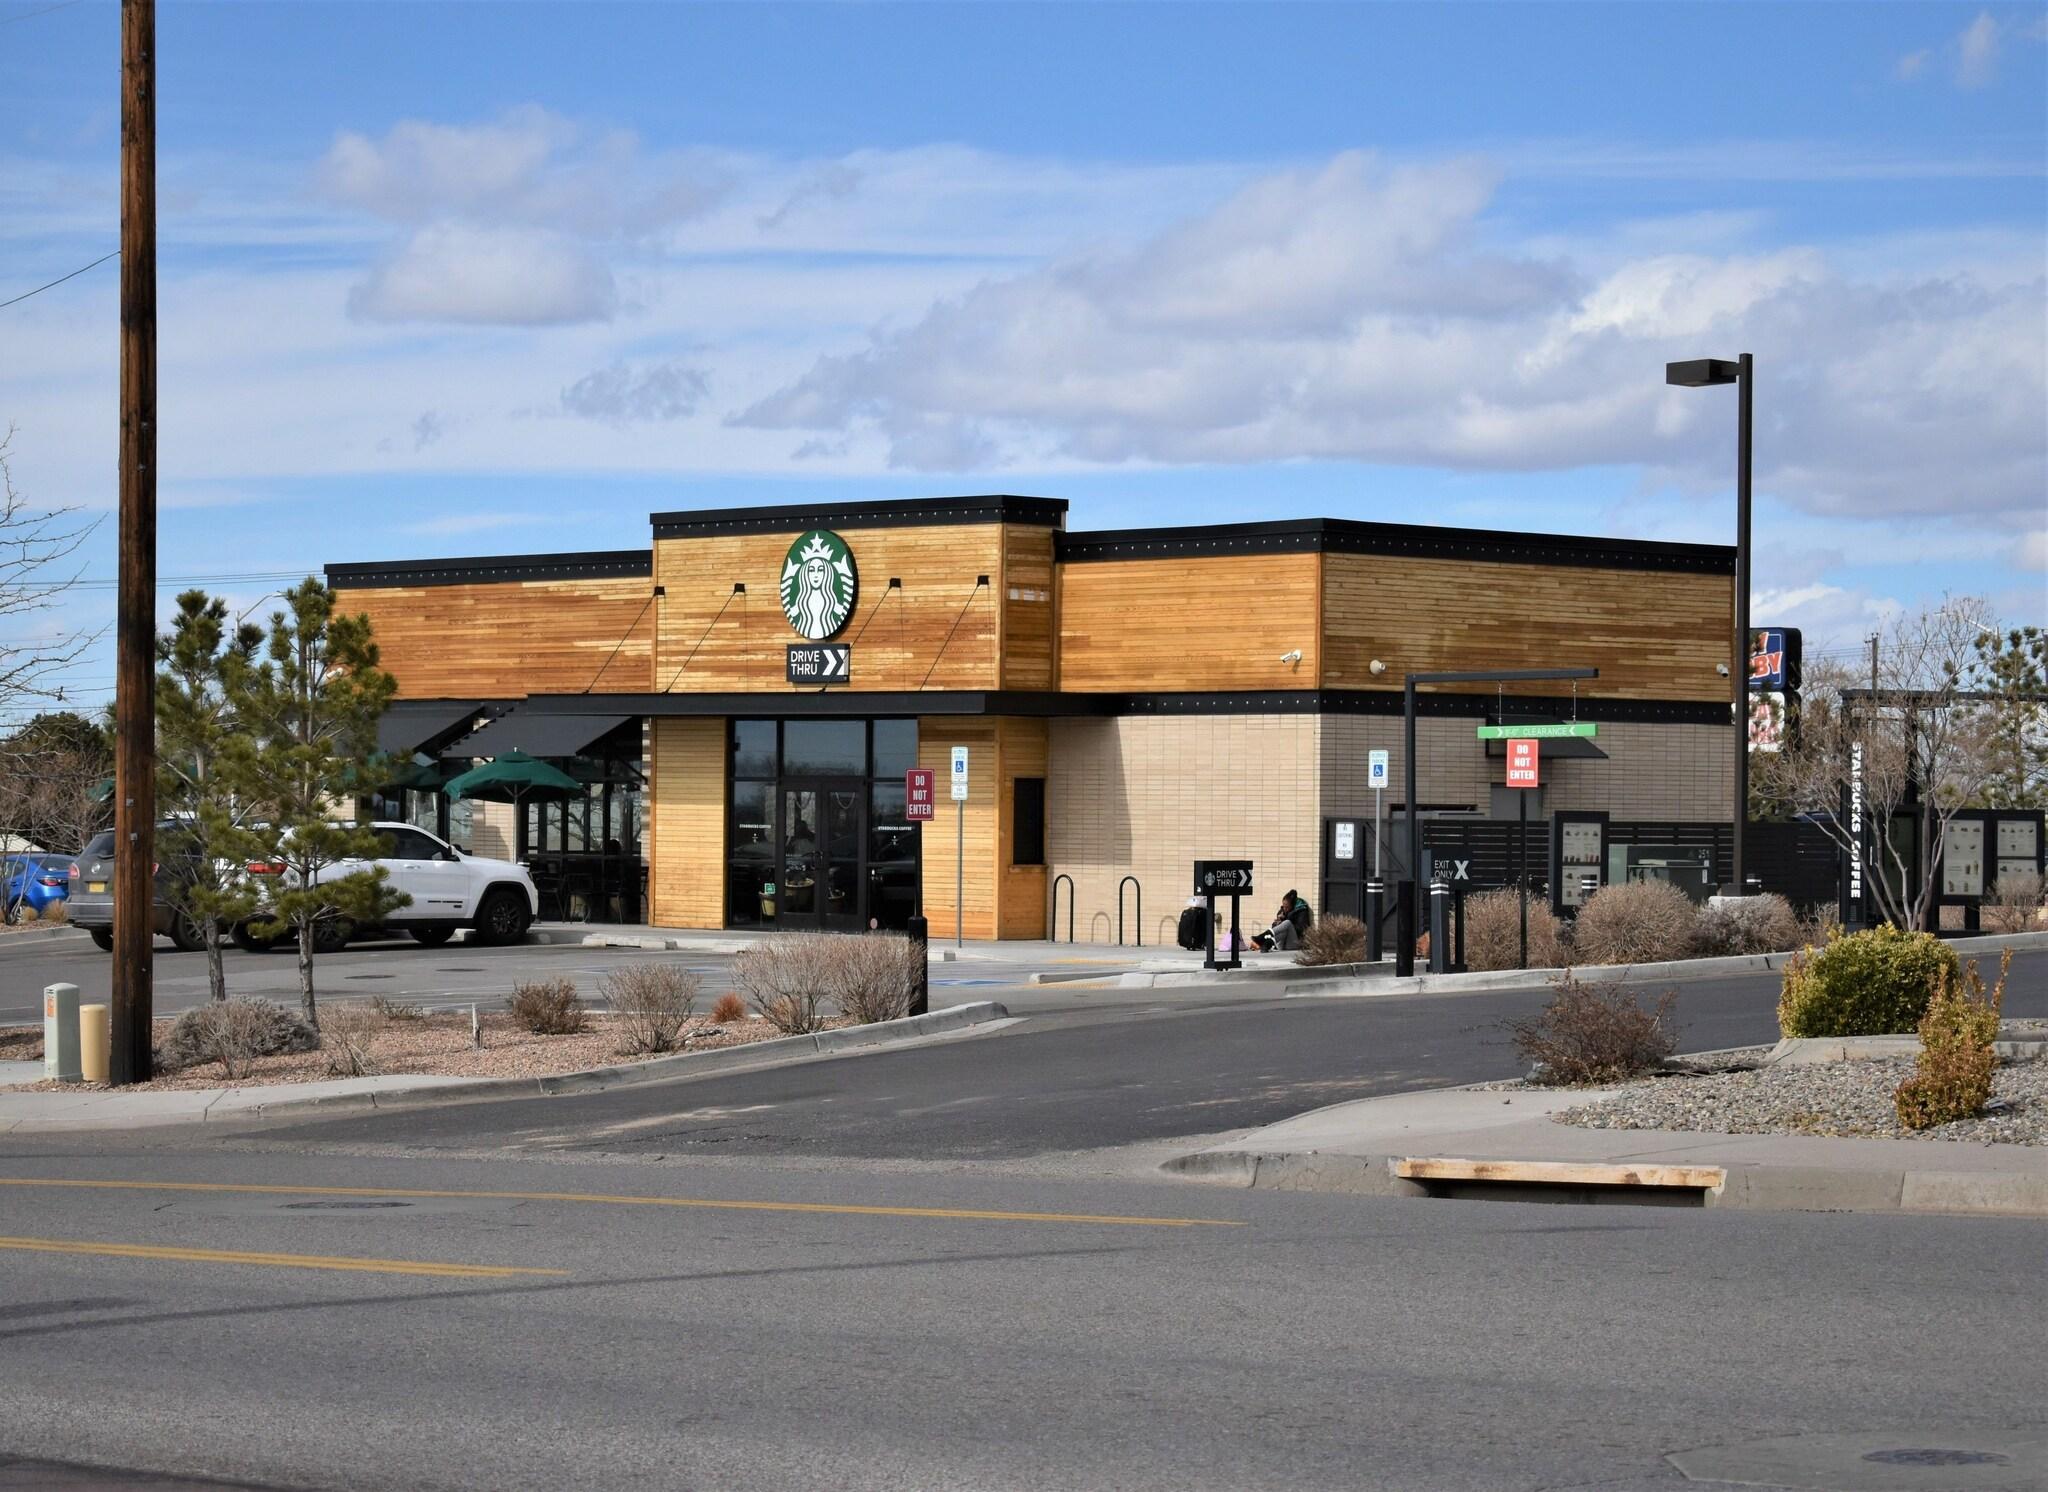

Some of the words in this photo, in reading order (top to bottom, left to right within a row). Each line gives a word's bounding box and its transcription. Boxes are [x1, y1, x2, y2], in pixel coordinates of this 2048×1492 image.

[790, 650, 820, 662] DRIVE
[791, 663, 818, 675] THRU
[1523, 726, 1567, 736] CLEARANCE
[1516, 744, 1529, 754] DO
[1514, 757, 1531, 767] NOT
[1510, 769, 1535, 779] ENTER
[915, 775, 925, 786] DO
[912, 790, 927, 800] NOT
[909, 804, 931, 815] ENTER
[1434, 860, 1450, 869] EXIT
[1850, 840, 1861, 898] COFFEE
[1216, 870, 1237, 879] DRIVE
[1434, 870, 1454, 879] ONLY
[1216, 879, 1236, 887] THRU
